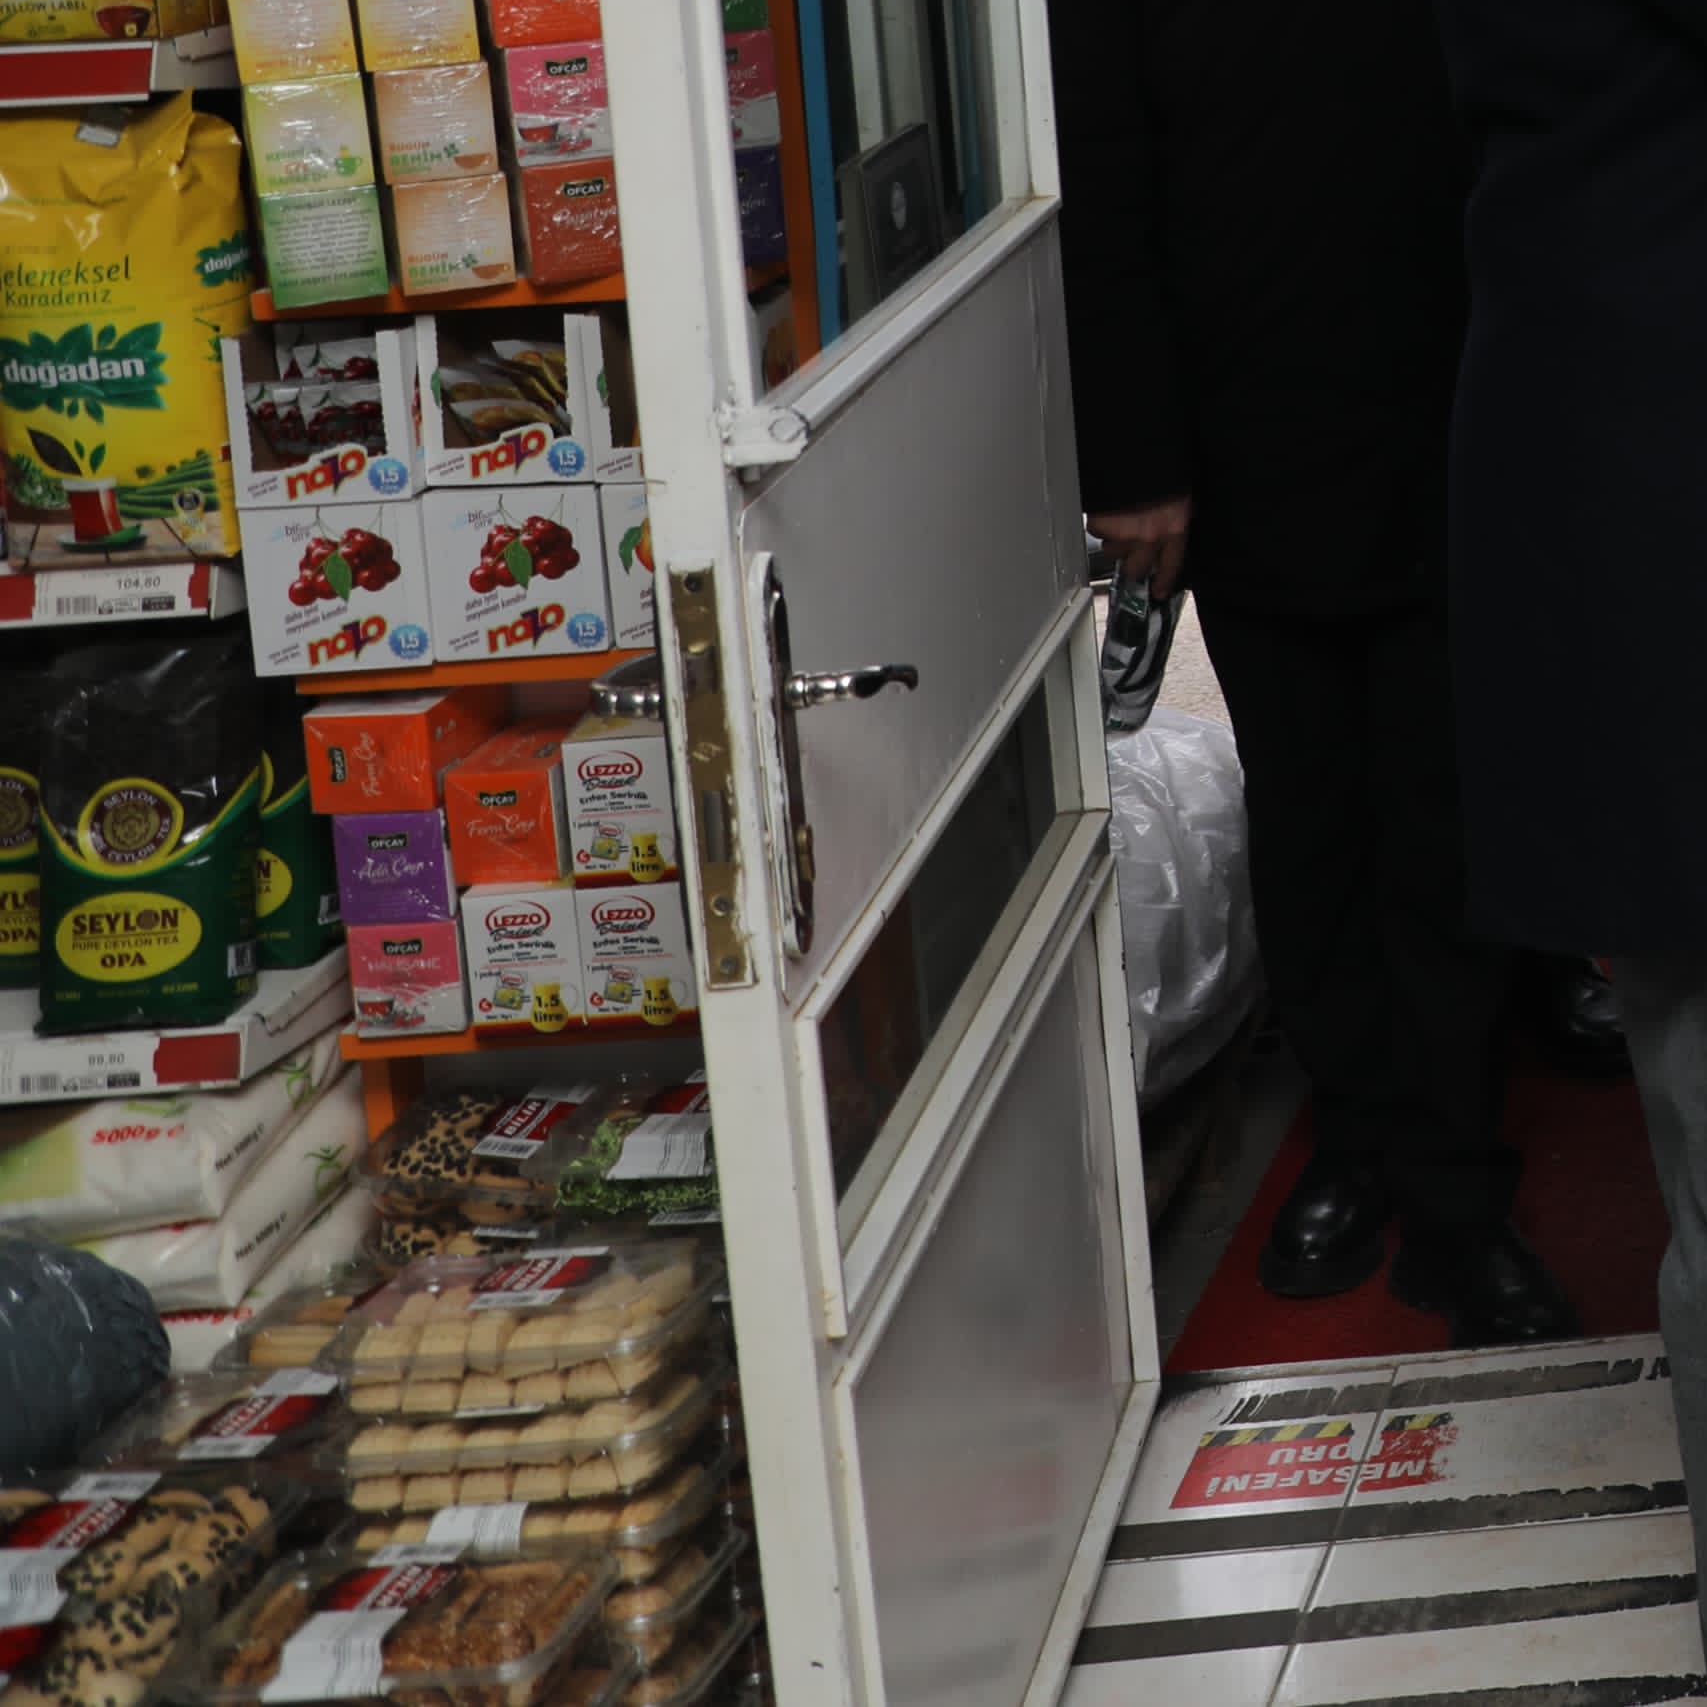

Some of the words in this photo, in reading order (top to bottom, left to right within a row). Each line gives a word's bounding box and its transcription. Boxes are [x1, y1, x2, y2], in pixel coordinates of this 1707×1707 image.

[0, 254, 132, 288] eleneksel
[4, 355, 147, 391] doğadan
[585, 761, 634, 776] LEZZO
[480, 792, 516, 806] OFÇAY
[370, 836, 406, 850] OFÇAY
[632, 843, 658, 860] 1.5
[630, 860, 661, 874] litre
[72, 907, 180, 936] SEYLON
[493, 912, 542, 927] LEZZO
[599, 907, 646, 922] LEZZO
[155, 935, 179, 947] TEA
[100, 953, 146, 969] OPA
[535, 994, 561, 1009] 1.5
[646, 987, 670, 1002] 1.5
[533, 1009, 564, 1024] litre
[643, 1003, 674, 1017] litre
[1205, 1457, 1427, 1499] MESAFENİ
